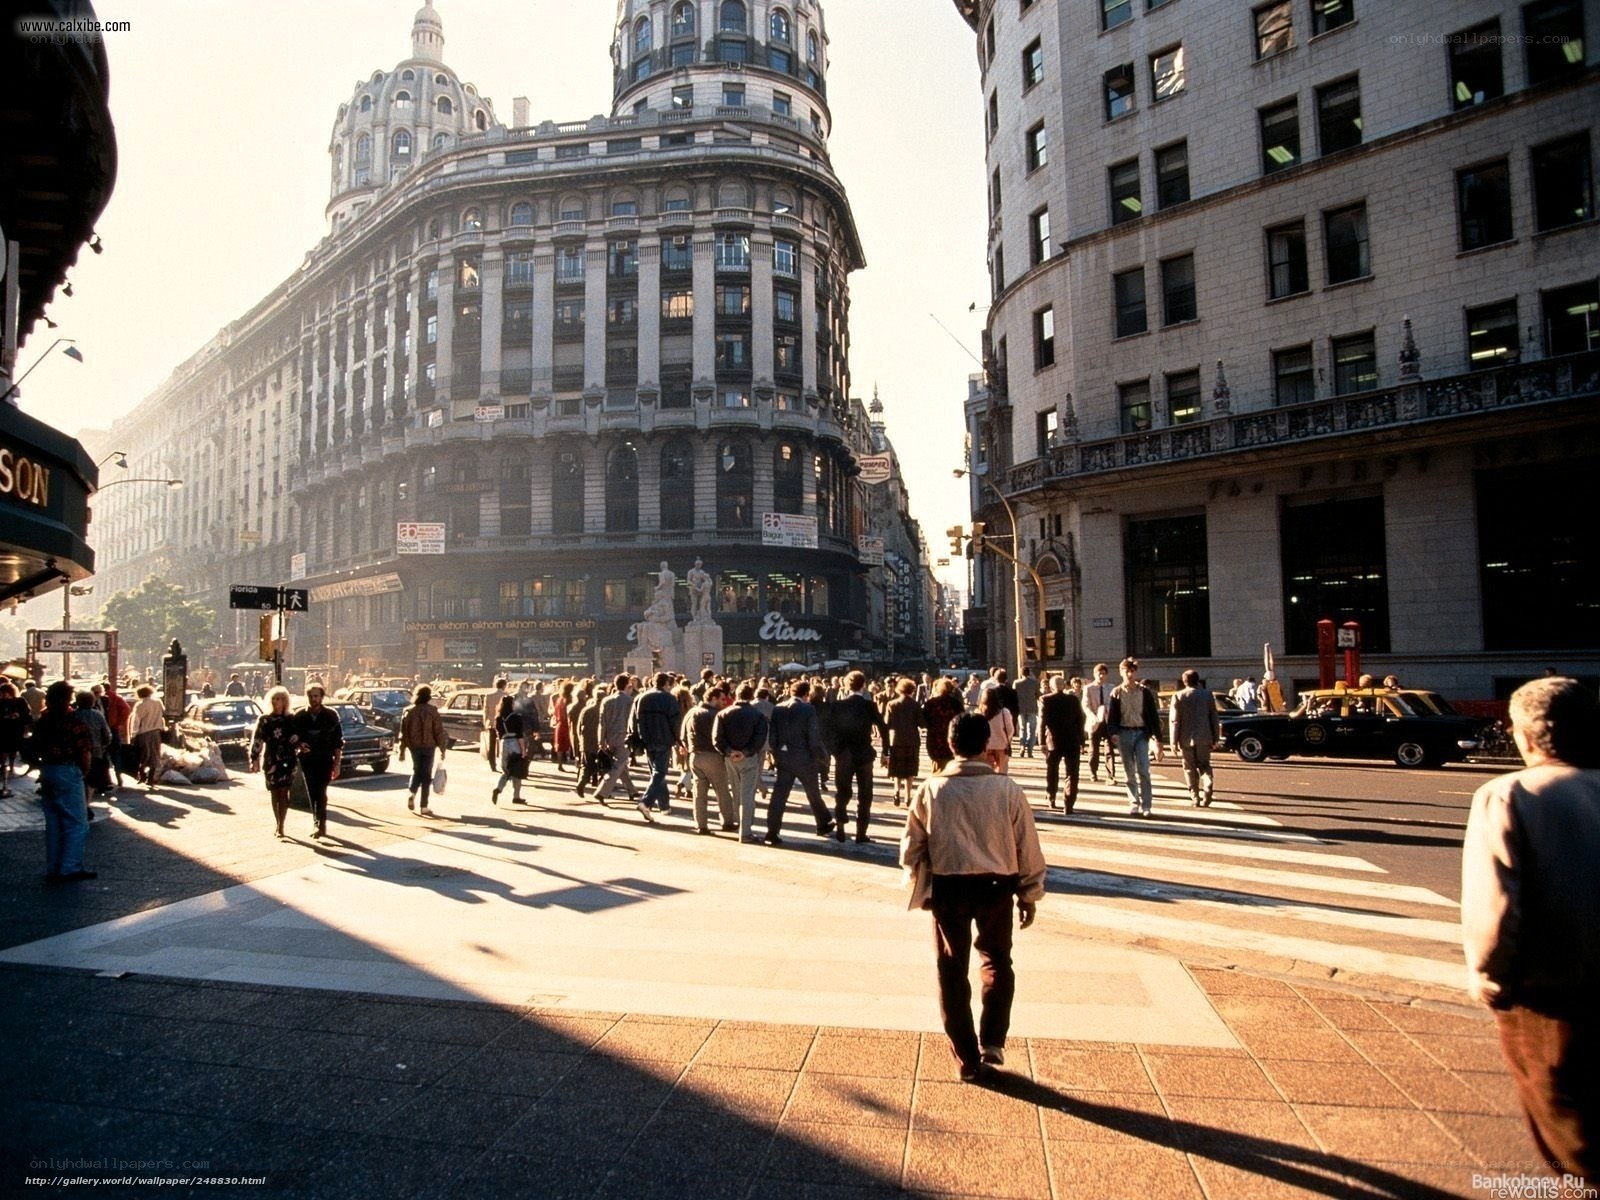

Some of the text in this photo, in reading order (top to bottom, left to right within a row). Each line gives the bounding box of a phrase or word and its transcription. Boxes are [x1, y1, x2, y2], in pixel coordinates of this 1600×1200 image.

[231, 585, 258, 593] Florida
[759, 611, 822, 641] Etam
[44, 640, 52, 649] D
